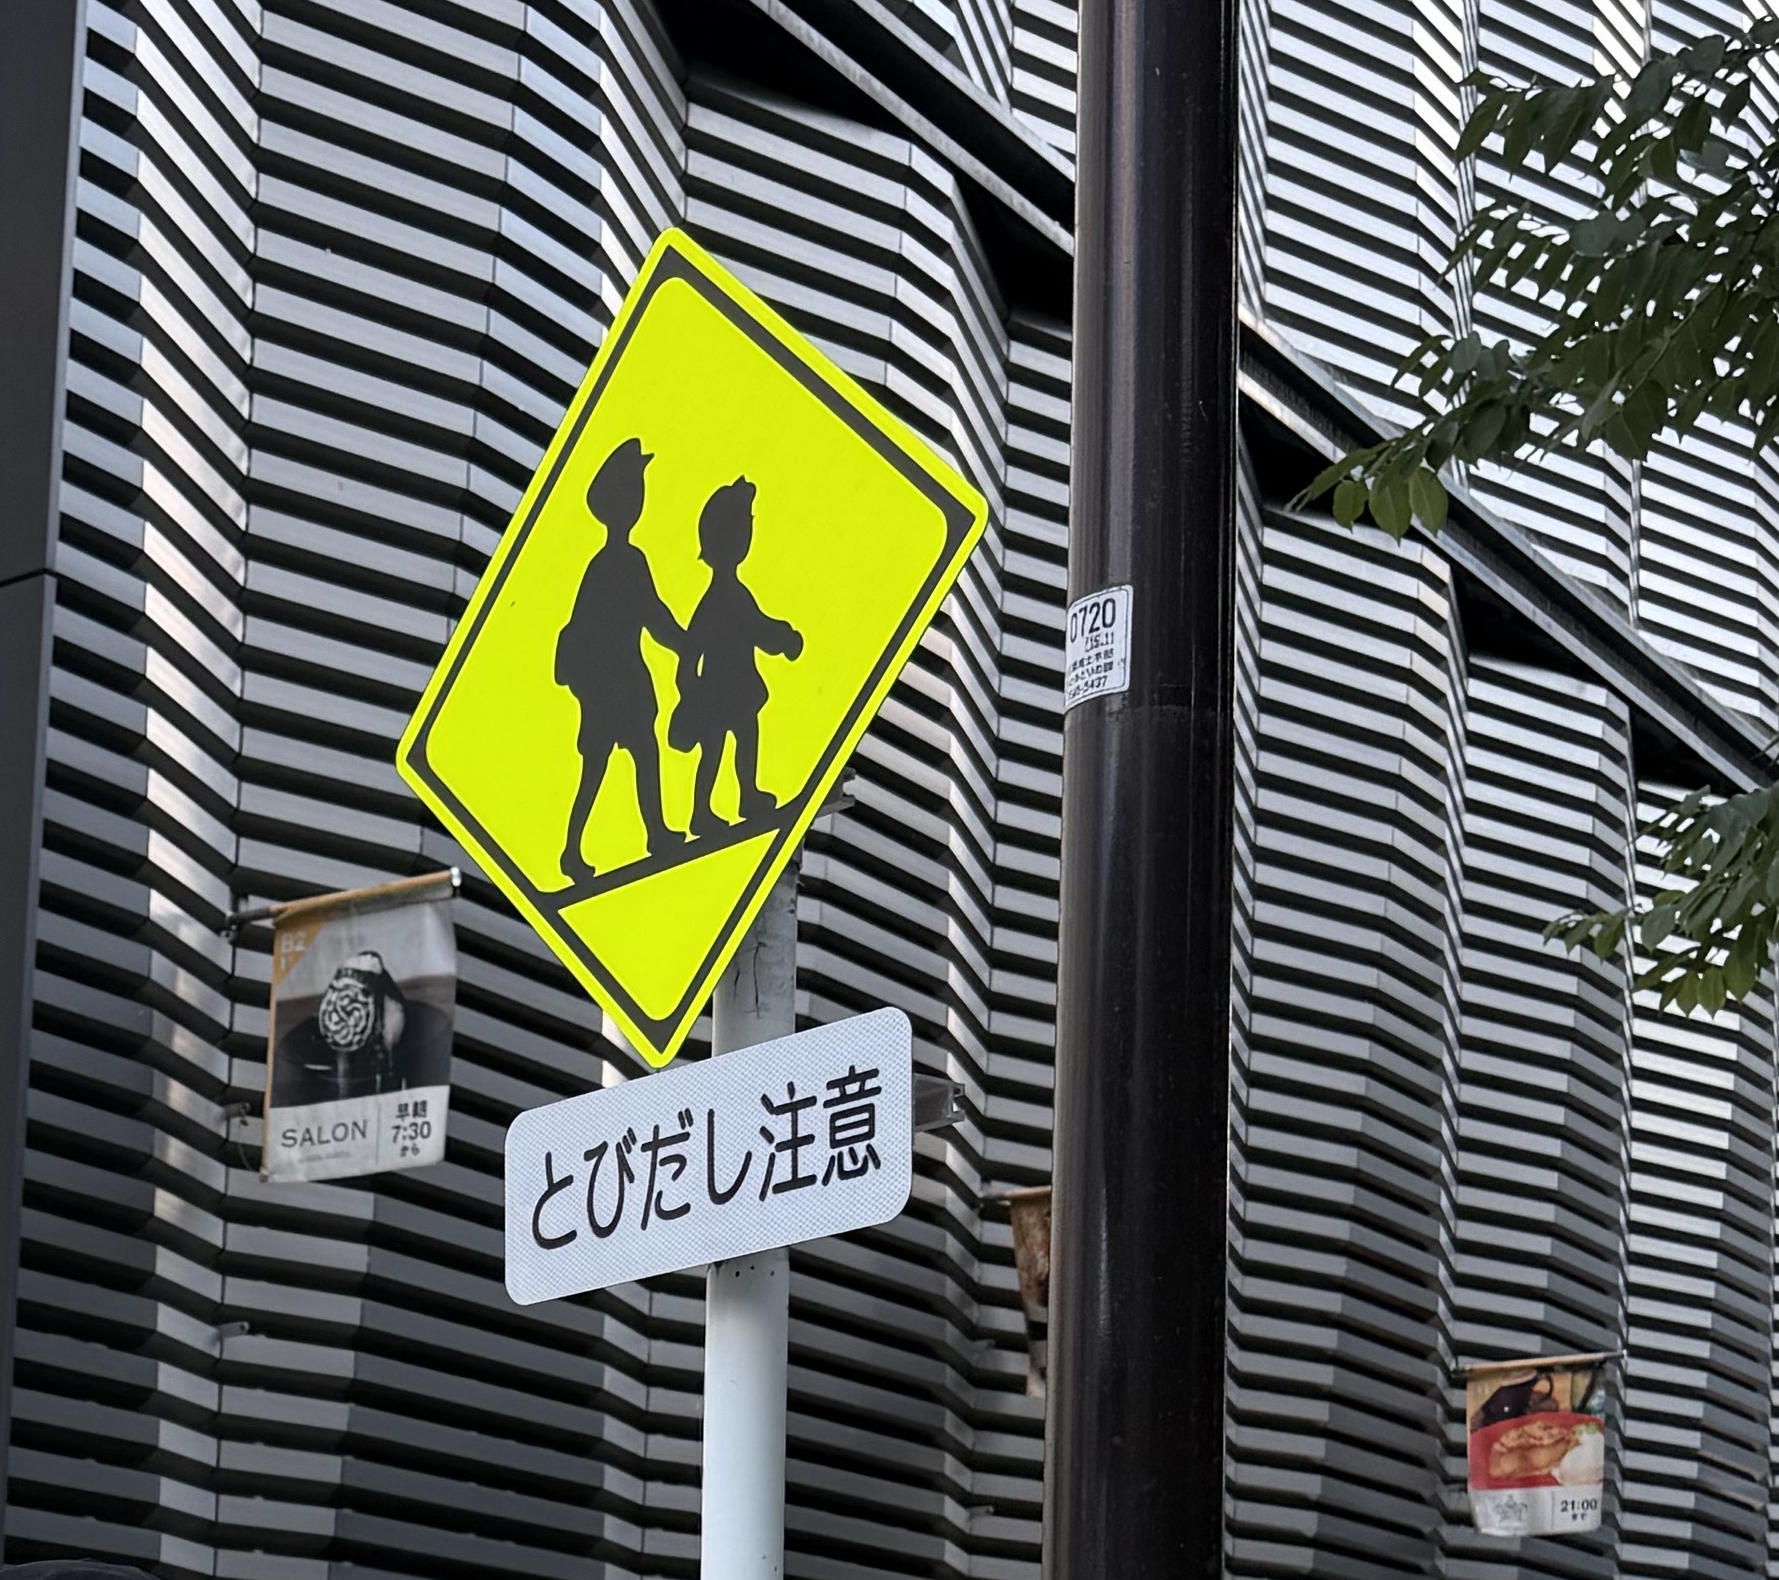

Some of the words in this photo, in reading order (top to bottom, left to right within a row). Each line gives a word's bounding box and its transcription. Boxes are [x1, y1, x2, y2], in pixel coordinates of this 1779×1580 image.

[280, 1118, 369, 1149] SALON
[390, 1120, 432, 1144] 7:30
[532, 1065, 882, 1250] とびだし注意
[1560, 1498, 1598, 1513] 21:00
